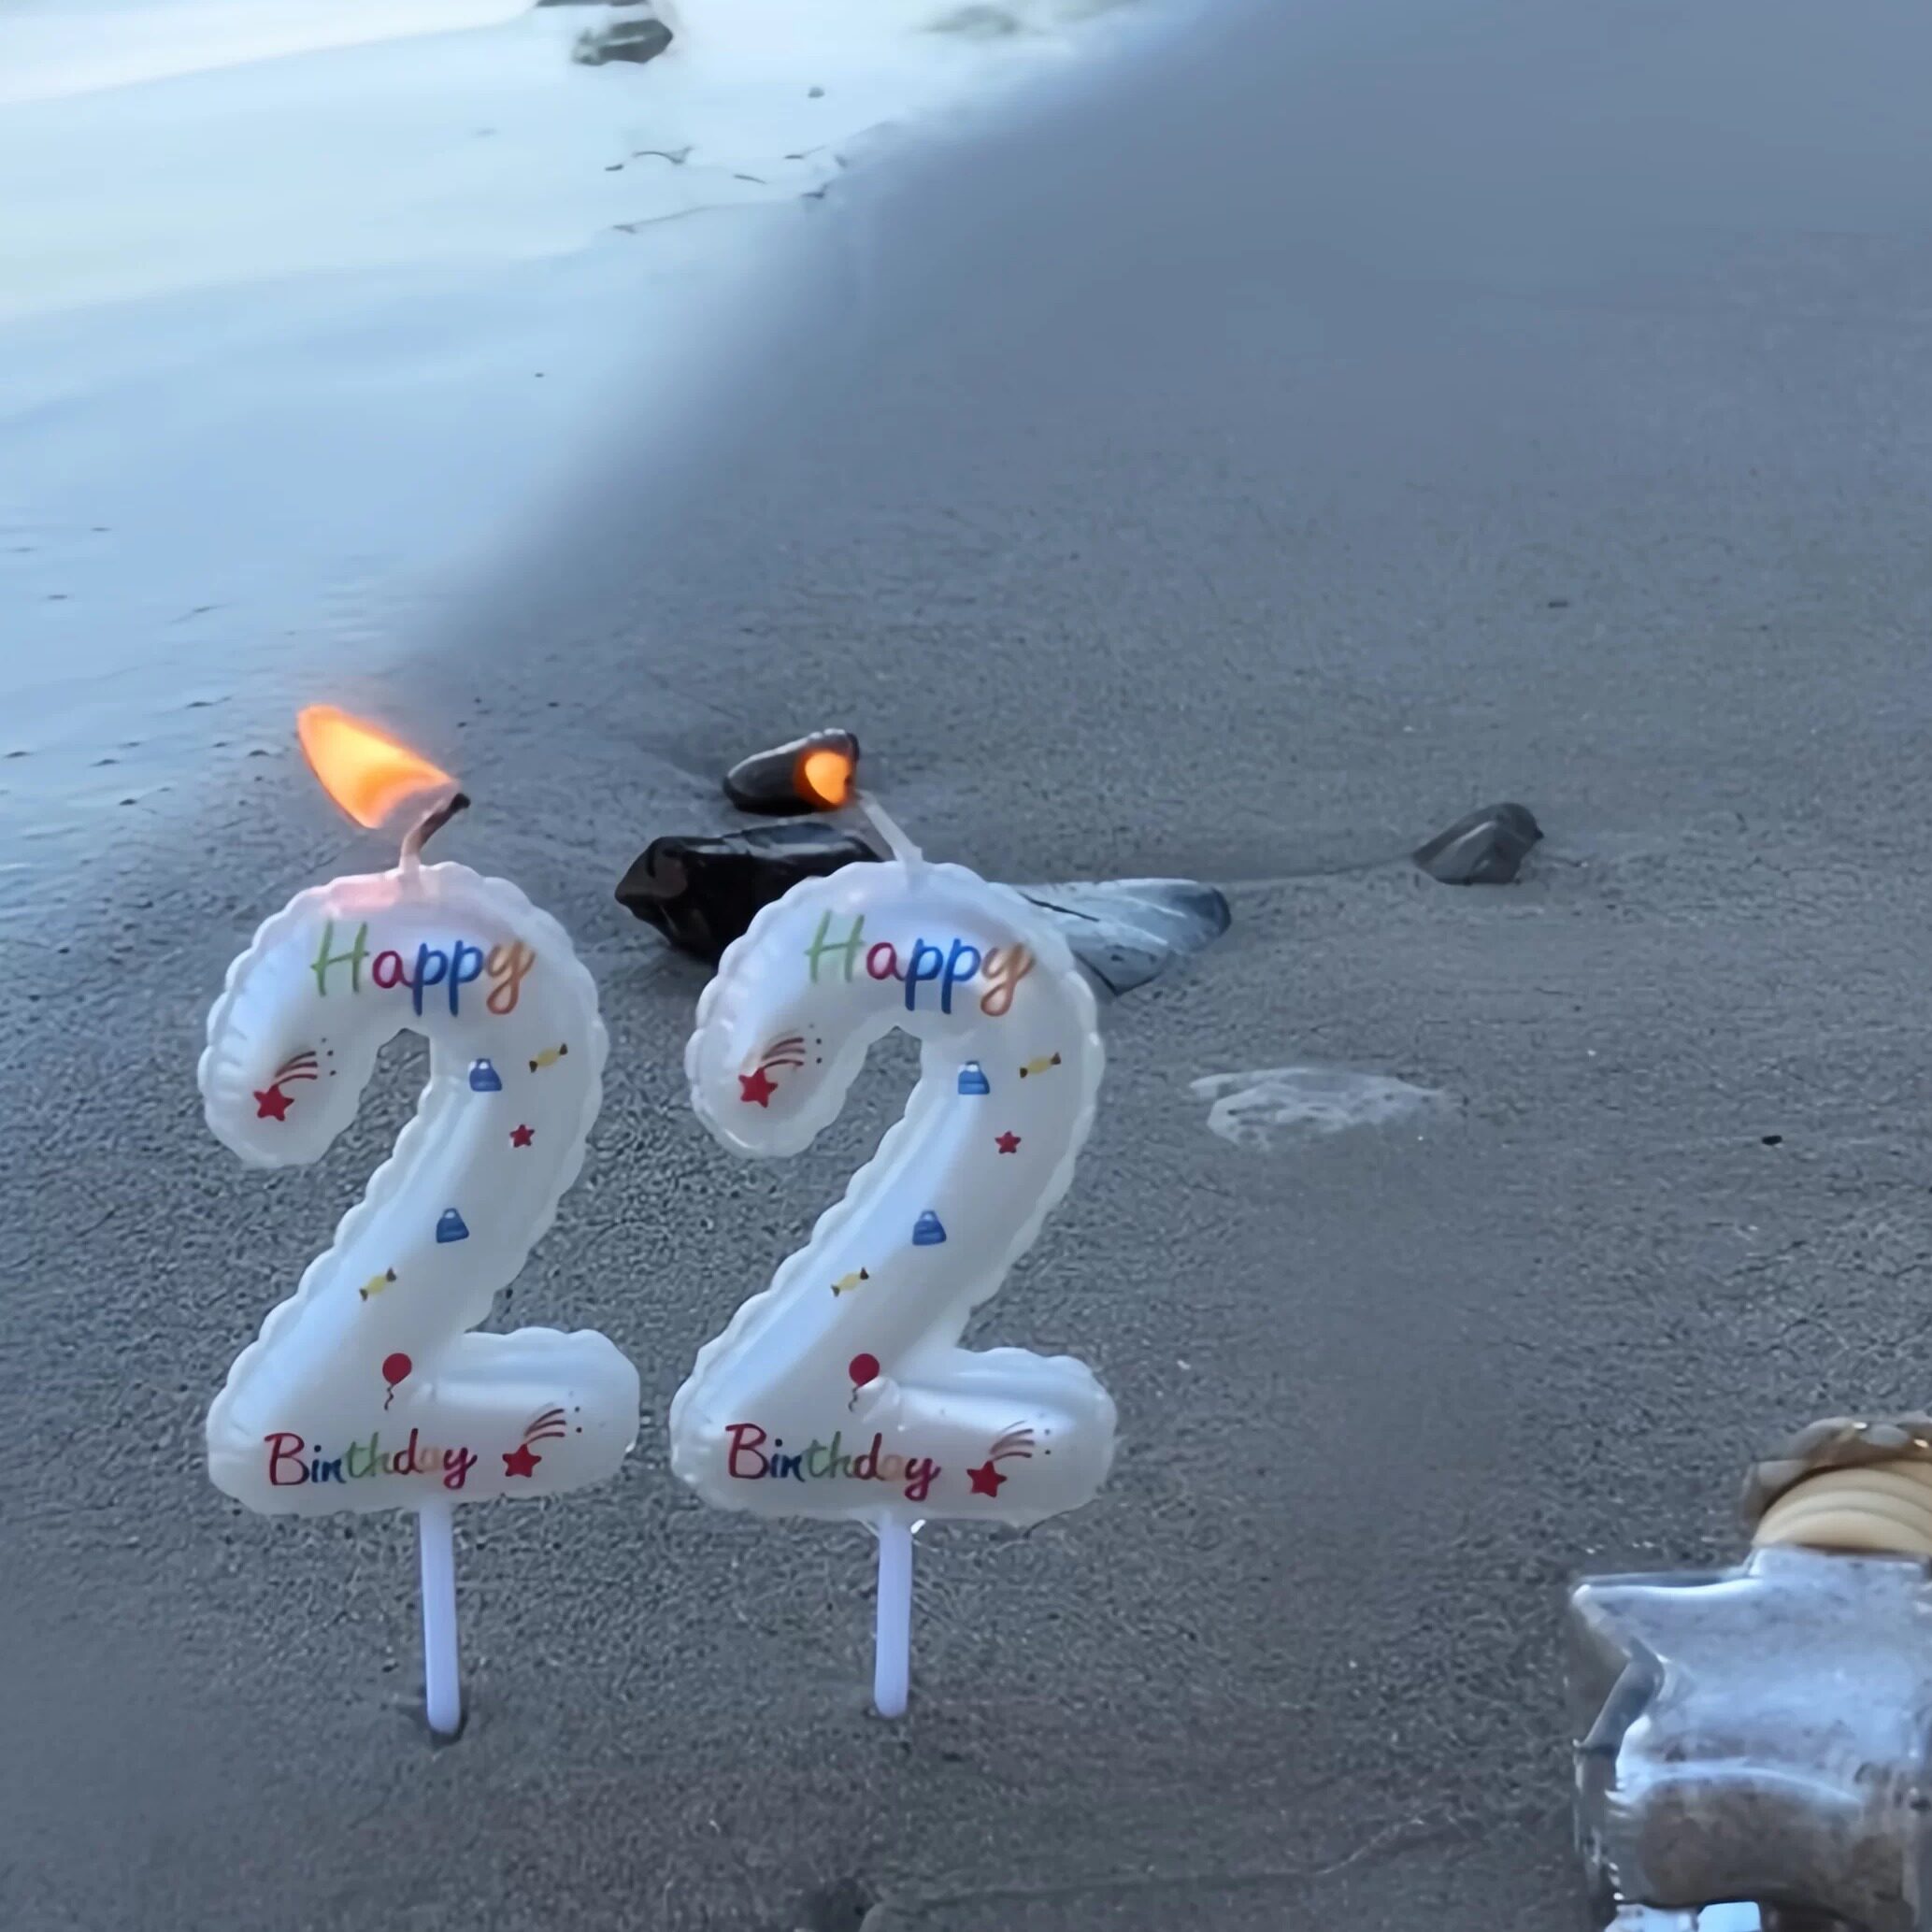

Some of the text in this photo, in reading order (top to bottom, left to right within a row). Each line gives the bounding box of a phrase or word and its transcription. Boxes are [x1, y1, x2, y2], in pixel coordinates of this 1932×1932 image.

[310, 921, 537, 1018] Happy
[804, 909, 1037, 1017] Happy
[265, 1427, 478, 1490] Birthday
[725, 1423, 941, 1502] Birthday
